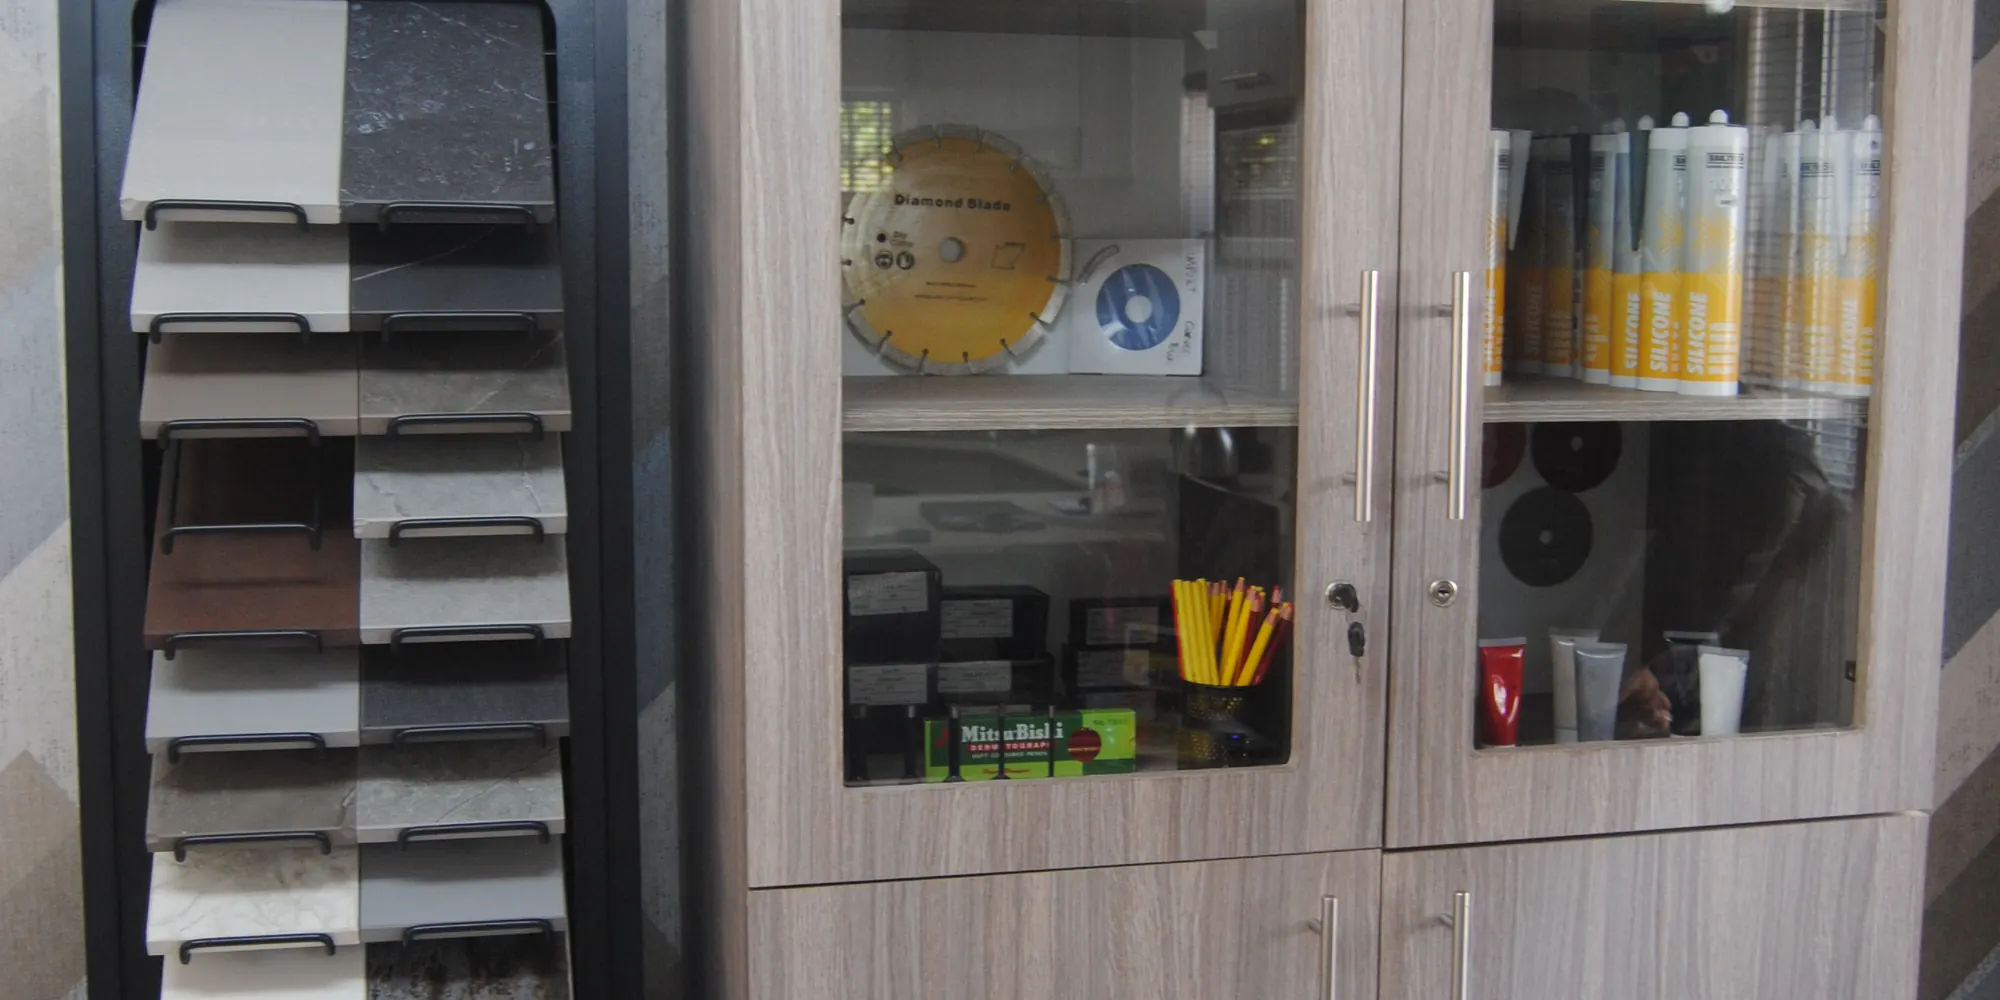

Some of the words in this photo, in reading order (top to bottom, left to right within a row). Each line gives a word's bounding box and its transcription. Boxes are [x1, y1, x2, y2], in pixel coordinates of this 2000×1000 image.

[895, 194, 963, 209] Diamond
[967, 199, 1011, 211] Blade
[1650, 291, 1671, 373] SILICONE
[1687, 291, 1707, 376] SILICONE
